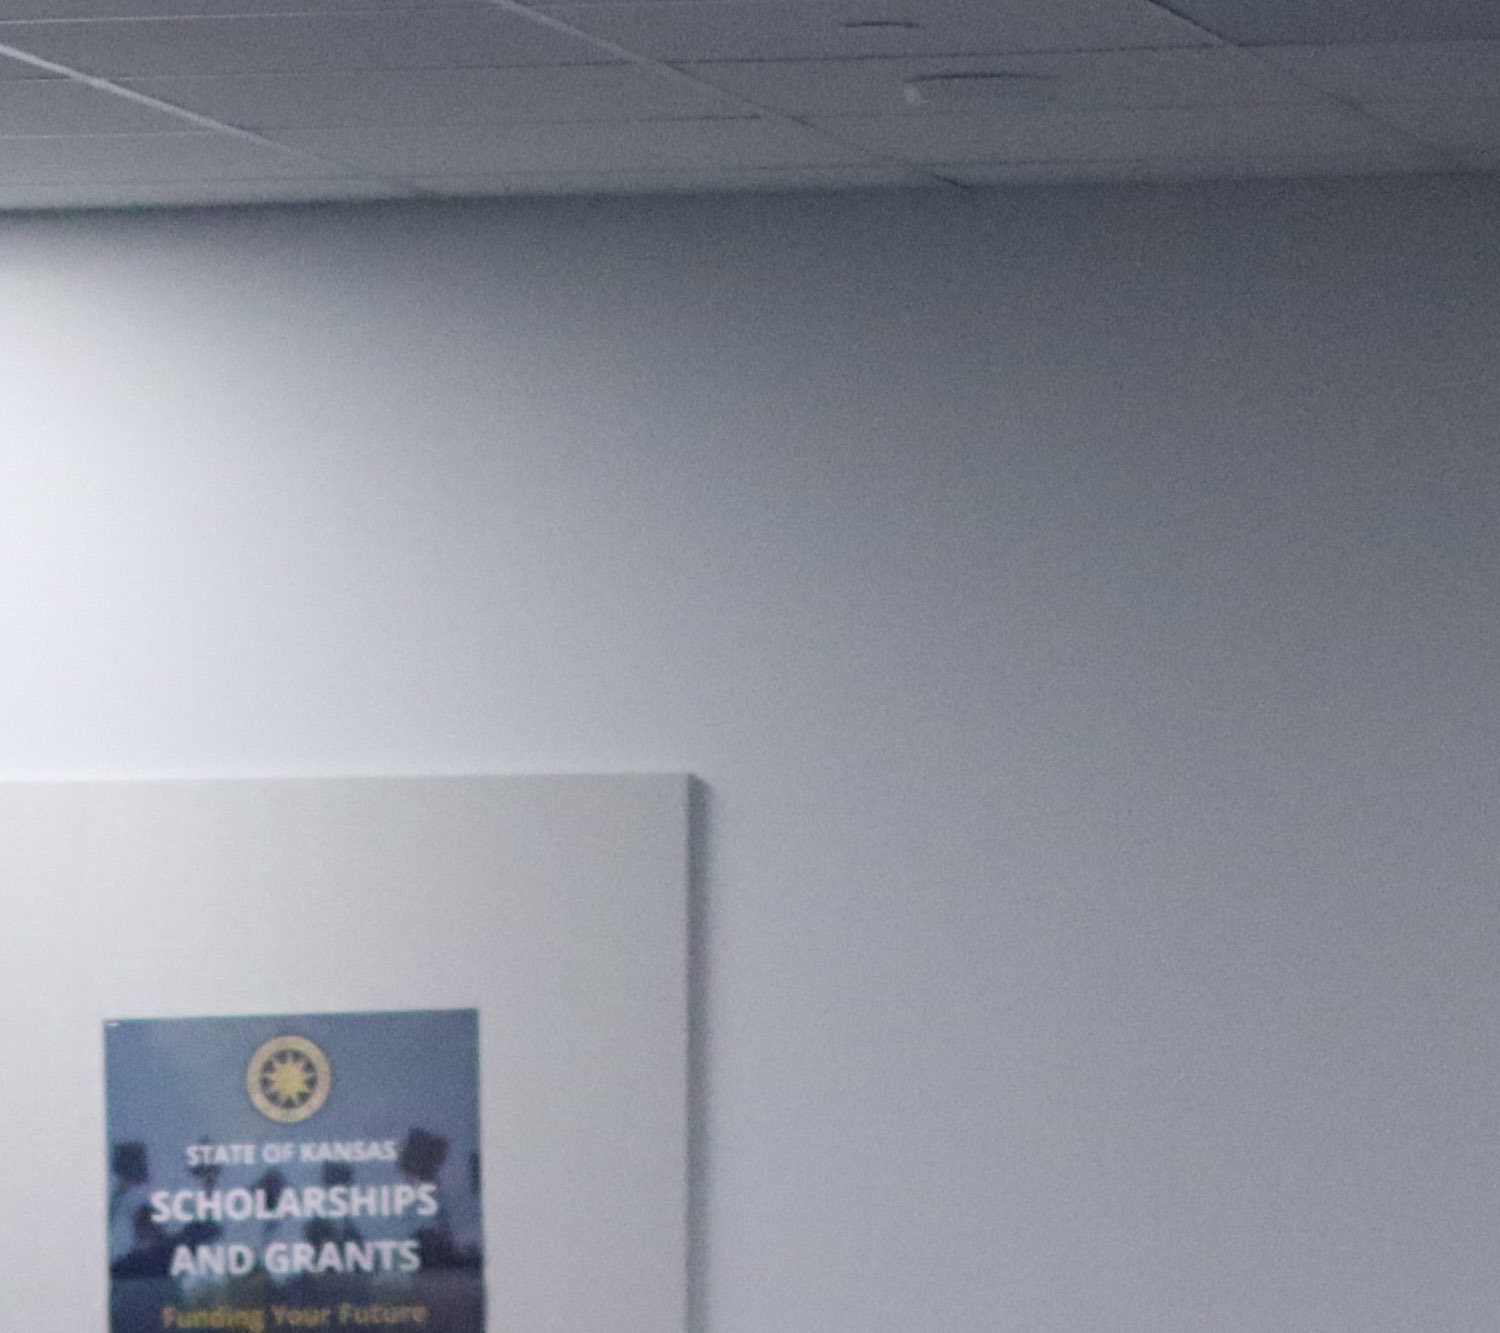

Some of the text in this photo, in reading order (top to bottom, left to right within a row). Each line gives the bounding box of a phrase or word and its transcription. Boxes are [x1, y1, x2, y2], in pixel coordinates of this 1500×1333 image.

[186, 1140, 399, 1167] STATE OF KANSAS
[150, 1184, 439, 1223] SCHOLARSHIPS
[169, 1240, 421, 1276] AND GRANTS
[161, 1302, 430, 1333] Funding Your Future
